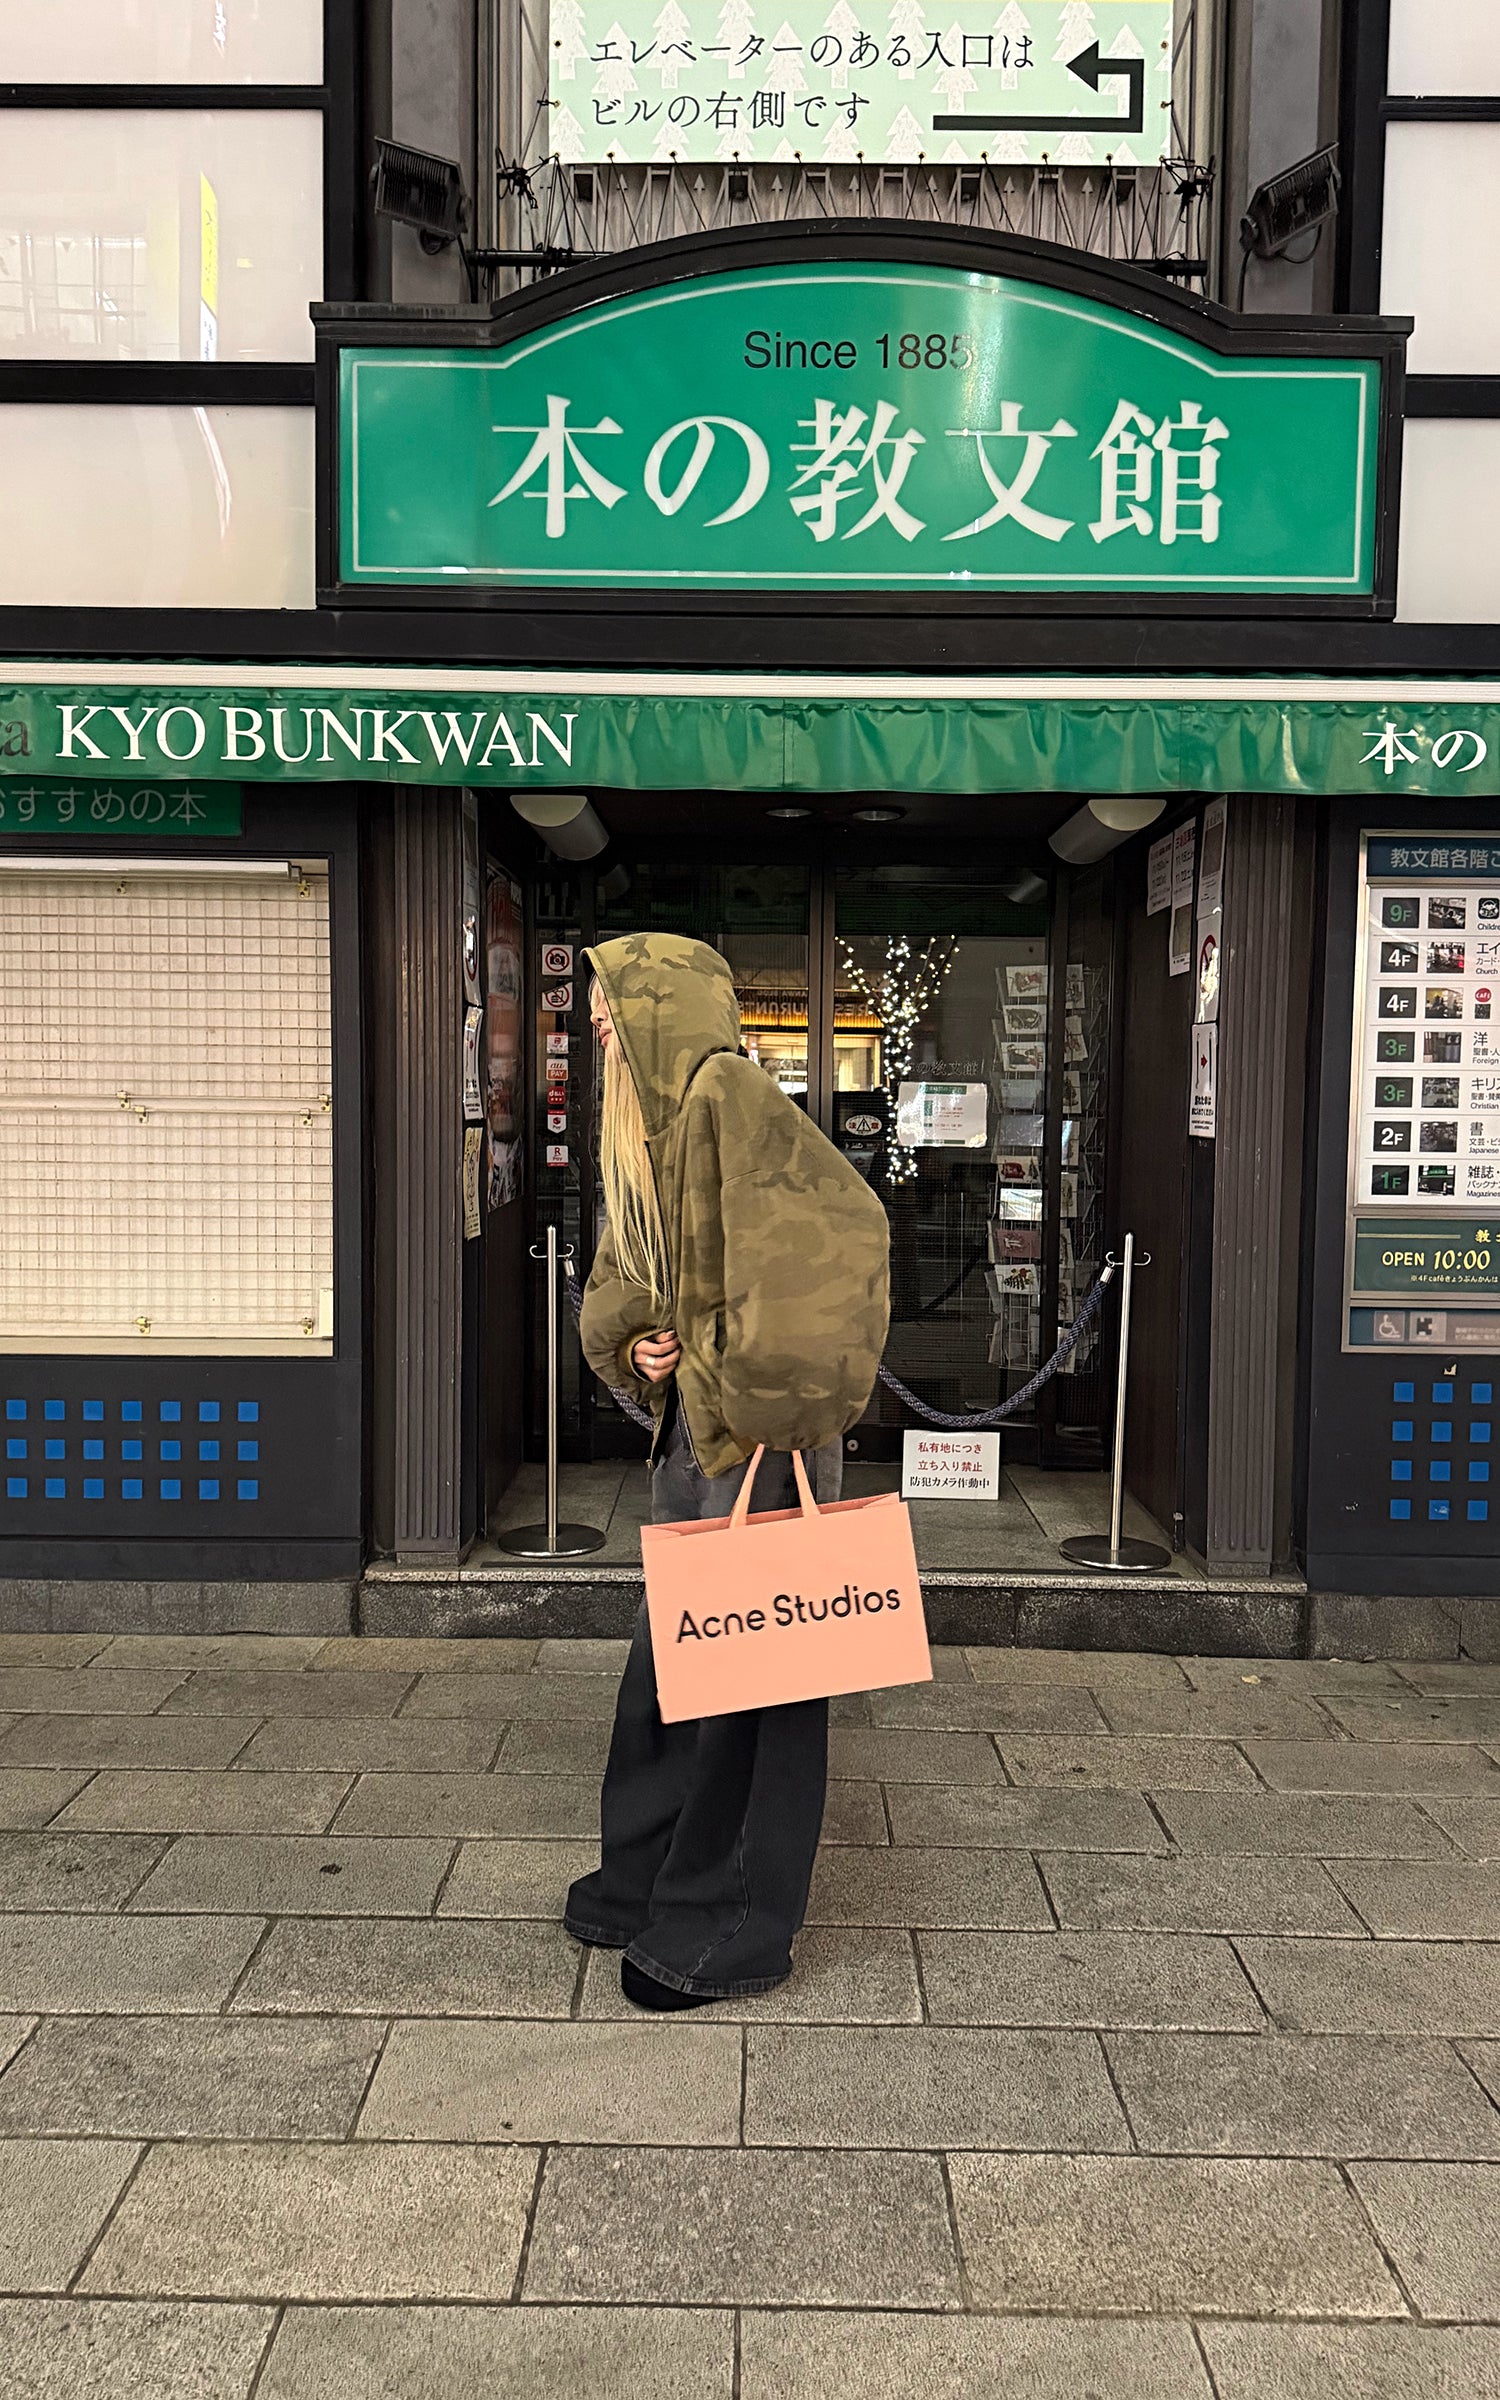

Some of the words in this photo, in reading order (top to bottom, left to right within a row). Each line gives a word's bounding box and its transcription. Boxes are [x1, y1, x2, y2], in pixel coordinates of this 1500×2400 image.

[589, 32, 1035, 70] エレベーターのある入口は
[590, 90, 872, 130] ビルの右側です
[743, 330, 857, 370] Since
[876, 332, 975, 371] 1885
[487, 394, 1231, 545] 本の教文館
[0, 720, 32, 757] a
[55, 704, 207, 761] KYO
[219, 706, 579, 767] BUNKWAN
[1358, 721, 1487, 775] 本の
[0, 786, 207, 827] すすめの本
[1389, 904, 1412, 923] 9F
[1388, 949, 1411, 968] 4F
[1475, 967, 1498, 975] Church
[1386, 994, 1409, 1012] 4F
[1384, 1038, 1407, 1056] 3F
[1473, 1031, 1488, 1047] 洋
[1472, 1056, 1499, 1065] Foreign
[1383, 1084, 1406, 1102] 3F
[1380, 1127, 1403, 1146] 2F
[554, 1147, 561, 1155] R
[1380, 1170, 1401, 1190] 1F
[1467, 1180, 1500, 1189] バックナ
[1382, 1251, 1425, 1267] OPEN
[1434, 1249, 1491, 1270] 10:00
[918, 1441, 982, 1454] 私有地につき
[918, 1460, 983, 1472] 立ち入り禁止
[910, 1476, 990, 1489] 防犯カメラ作動中
[675, 1609, 766, 1643] Acne
[773, 1585, 901, 1626] Studios
